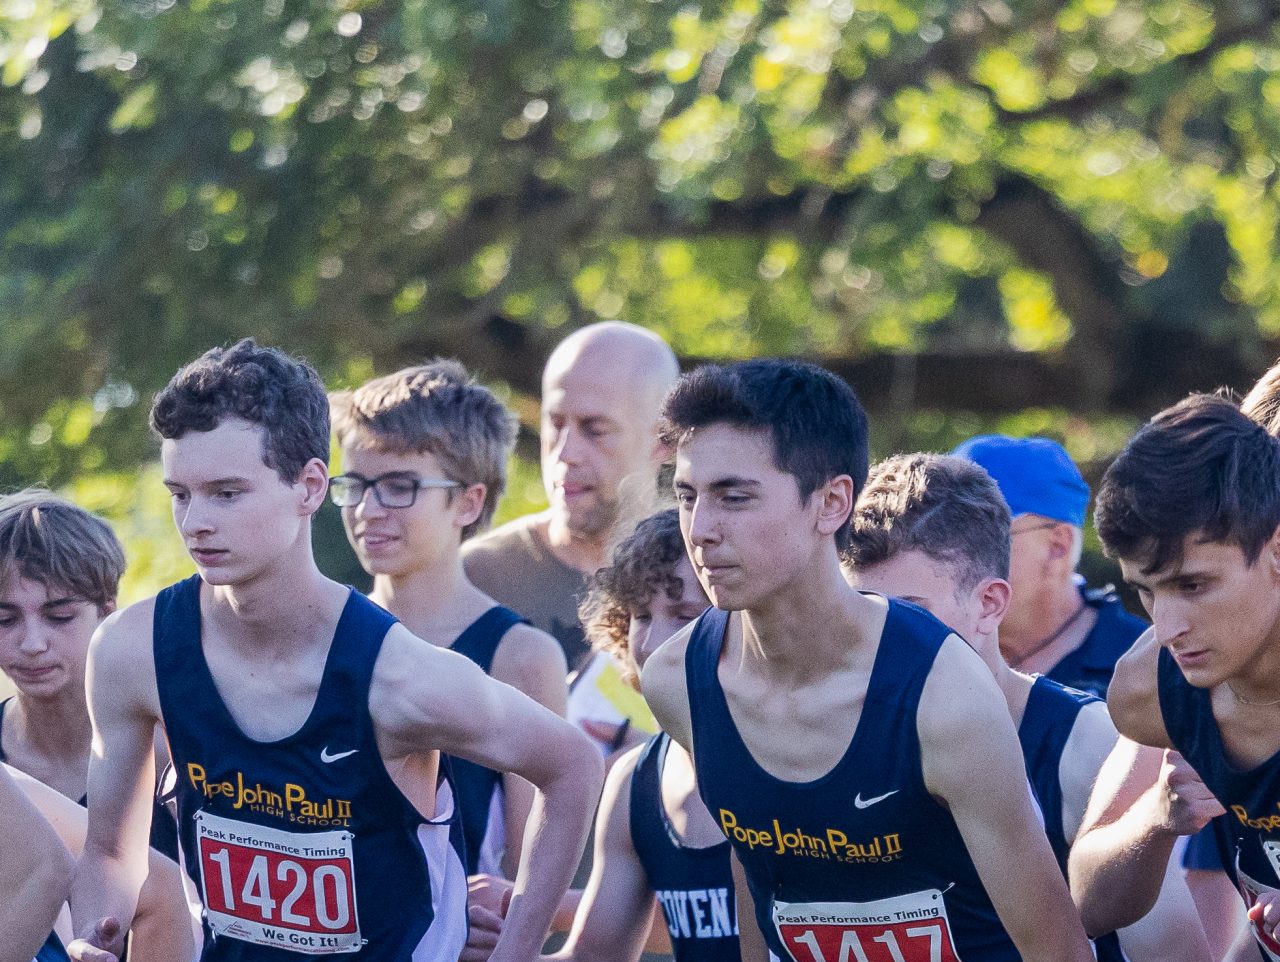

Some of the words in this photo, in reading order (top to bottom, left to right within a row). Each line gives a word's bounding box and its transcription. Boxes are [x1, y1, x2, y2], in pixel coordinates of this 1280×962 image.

[285, 783, 333, 818] Paul
[336, 799, 352, 818] II
[250, 805, 284, 818] HIGH
[289, 813, 350, 827] SCHOOL
[201, 826, 226, 840] Peak
[229, 832, 300, 855] Performance
[302, 847, 346, 858] Timing
[719, 808, 774, 850] Pope
[772, 818, 828, 855] John
[826, 828, 881, 858] Paul
[883, 833, 903, 855] II
[794, 848, 830, 861] HIGH
[837, 854, 902, 864] SCHOOL
[209, 848, 350, 930] 1420
[777, 915, 808, 923] Peak
[811, 914, 891, 924] Performance
[894, 907, 939, 921] Timing
[262, 927, 285, 941] We
[289, 933, 314, 947] Got
[319, 937, 339, 947] It!
